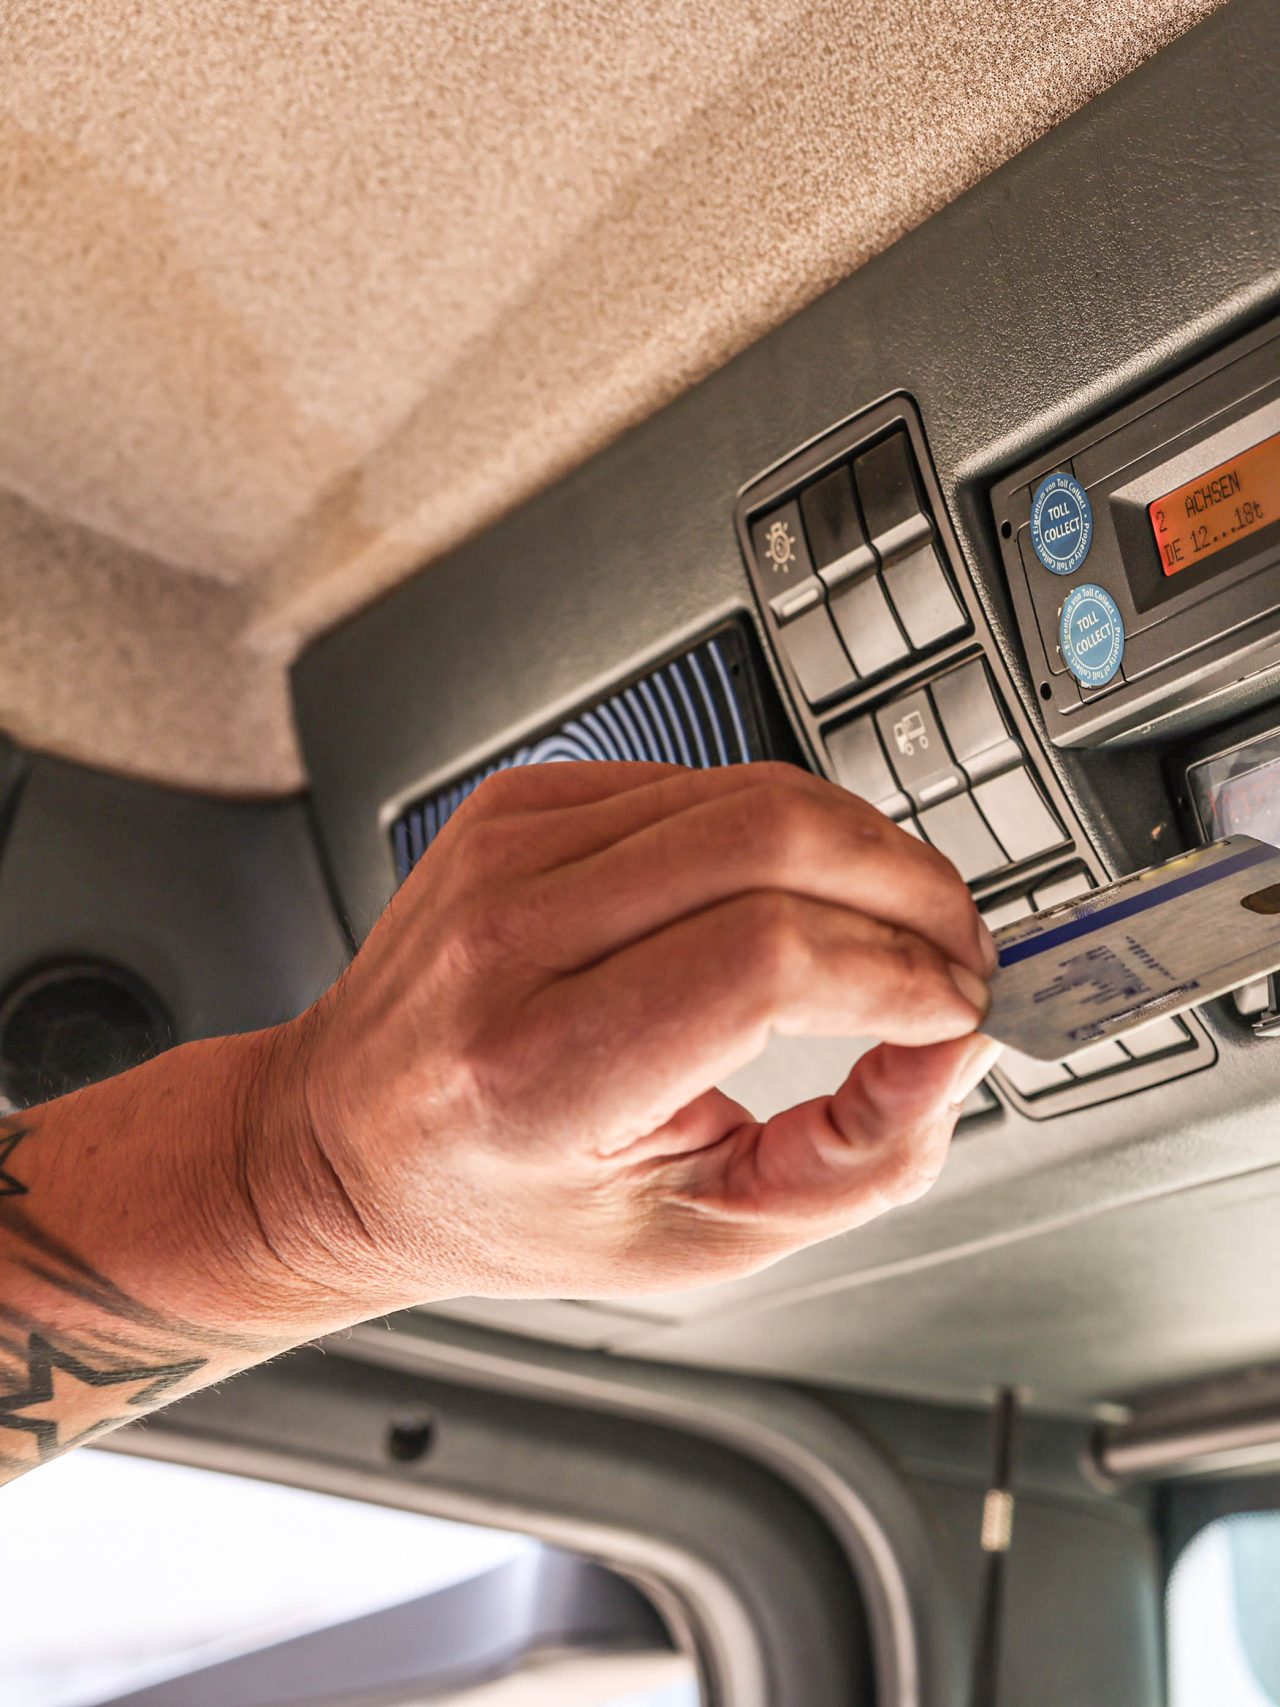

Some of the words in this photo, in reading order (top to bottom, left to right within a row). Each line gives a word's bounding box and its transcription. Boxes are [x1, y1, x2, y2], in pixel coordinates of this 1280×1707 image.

[1033, 491, 1046, 535] Eigentum
[1045, 483, 1056, 493] von
[1056, 478, 1069, 489] Toll
[1068, 482, 1086, 510] Collect
[1047, 502, 1070, 521] TOLL
[1156, 510, 1167, 533] 2
[1184, 470, 1241, 518] ACHSEN
[1044, 517, 1080, 543] COLLECT
[1074, 522, 1090, 560] Property
[1037, 543, 1056, 568] Collect
[1068, 559, 1075, 569] of
[1164, 538, 1185, 566] DE
[1056, 562, 1069, 570] Toll
[1082, 588, 1094, 597] Toll
[1094, 590, 1115, 616] Collect
[1077, 611, 1099, 633] TOLL
[1076, 623, 1111, 655] COLLECT
[1110, 626, 1121, 667] Property
[1092, 671, 1105, 680] Toll
